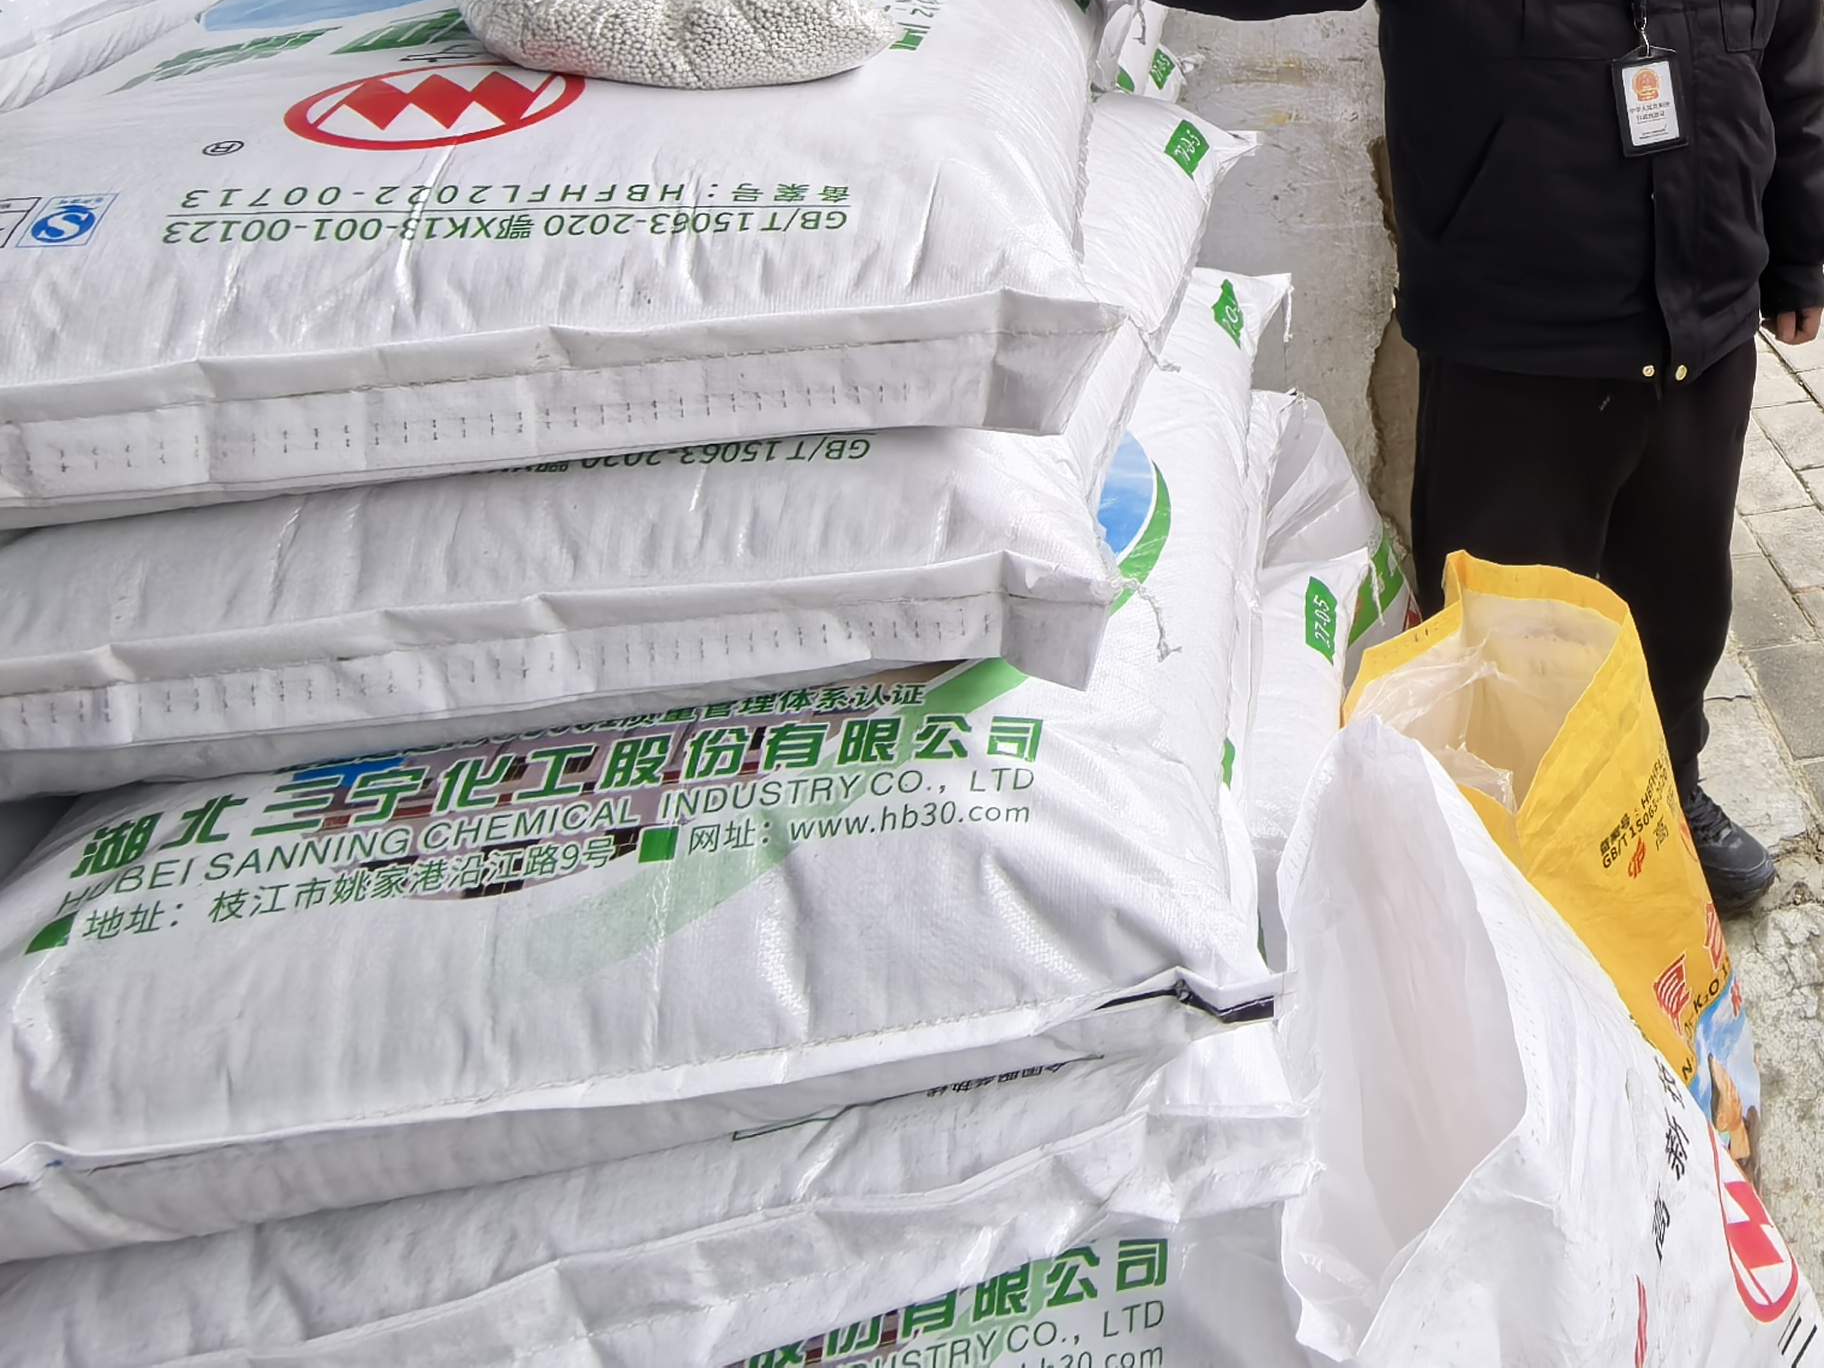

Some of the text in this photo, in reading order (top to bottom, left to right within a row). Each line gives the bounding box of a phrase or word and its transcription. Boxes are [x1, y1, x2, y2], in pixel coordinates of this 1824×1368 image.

[543, 209, 756, 237] 15063-2020
[762, 207, 848, 234] GB/T
[786, 437, 872, 463] GB/T
[70, 715, 1044, 878] 湖北三宁化工股份有限公司
[56, 858, 200, 917] HUBEI
[203, 828, 412, 881] SANNING
[421, 799, 641, 851] CHEMICAL
[660, 772, 858, 820] INDUSTRY
[970, 766, 1036, 794] LTD
[208, 832, 617, 924] 枝江市姚家港沿江路9号
[790, 800, 1031, 842] www.hb30.com
[1102, 1299, 1165, 1339] LTD
